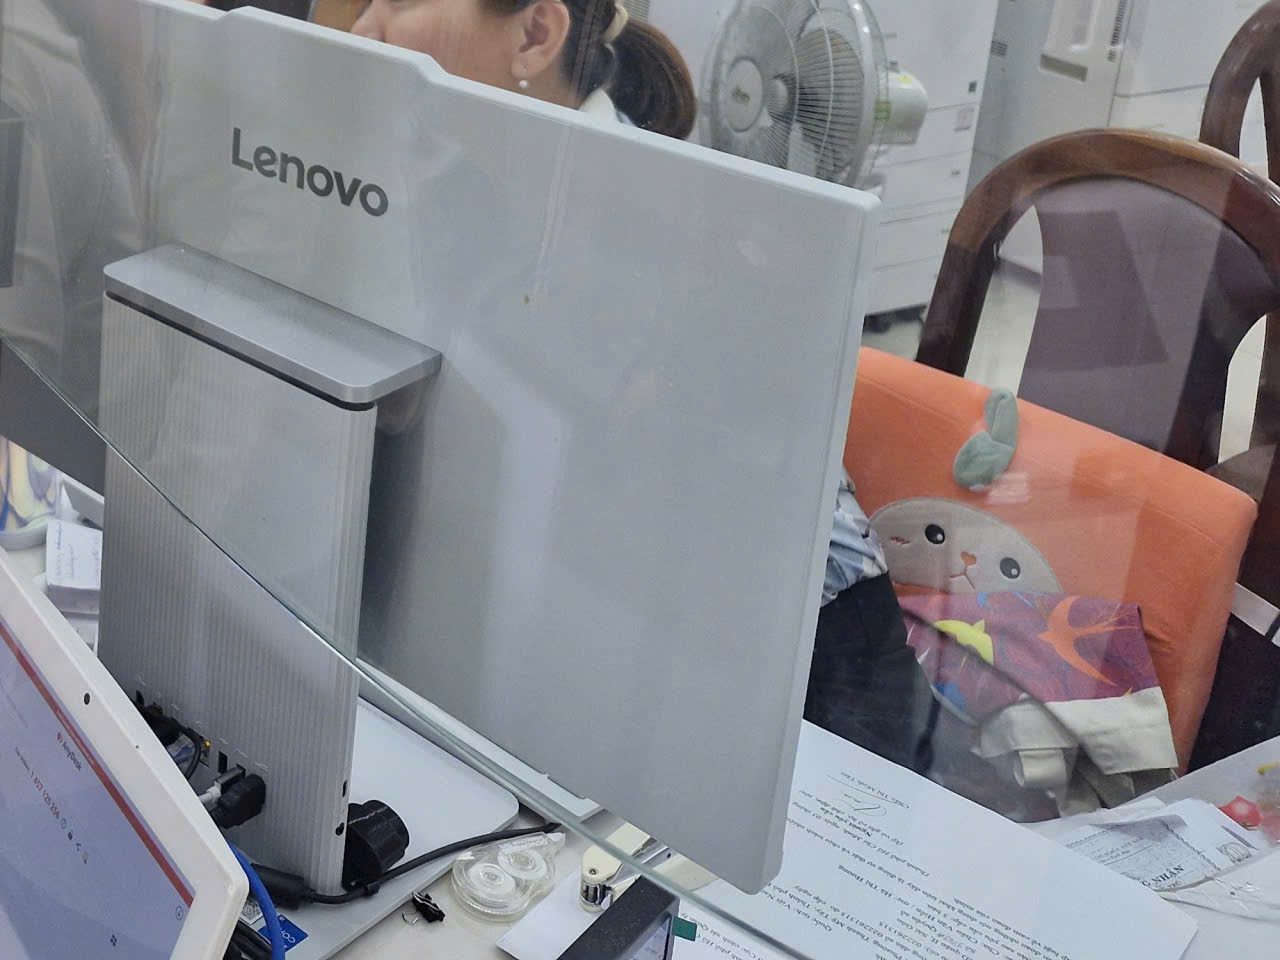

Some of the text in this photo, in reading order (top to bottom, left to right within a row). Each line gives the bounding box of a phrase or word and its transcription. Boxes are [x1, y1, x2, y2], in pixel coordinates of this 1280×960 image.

[231, 127, 389, 217] Lenovo
[62, 741, 82, 771] AnyDesk
[810, 916, 833, 932] Quốc
